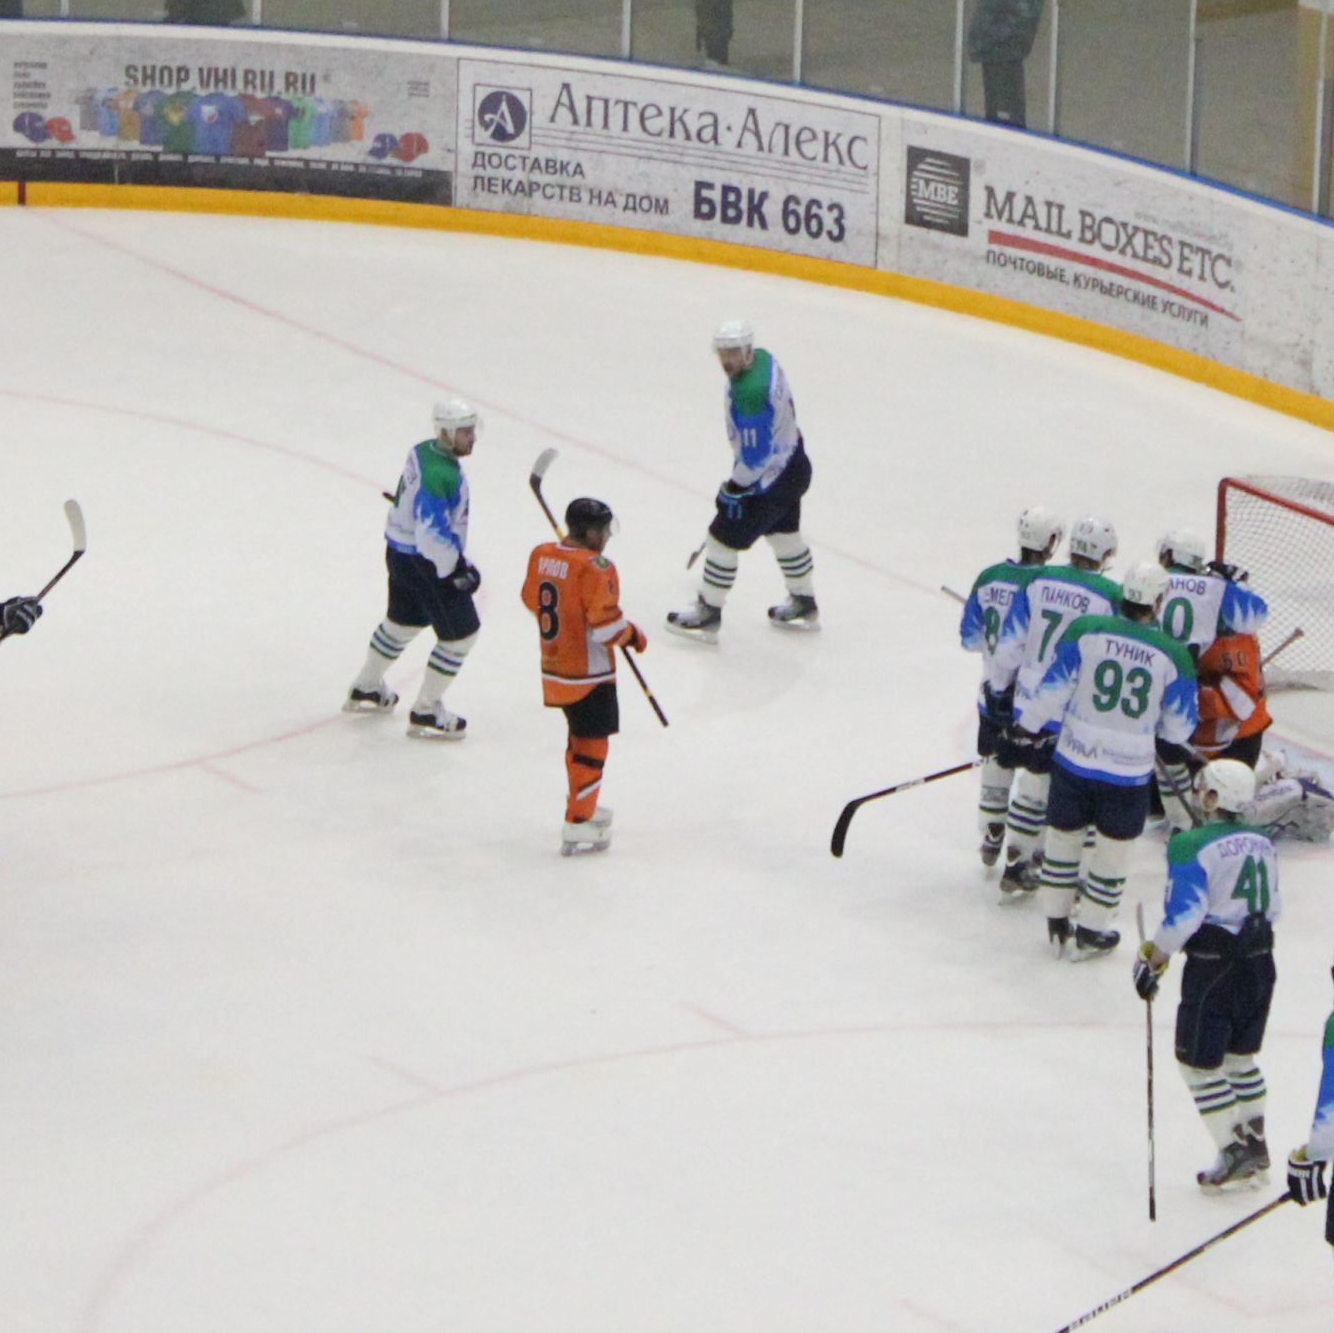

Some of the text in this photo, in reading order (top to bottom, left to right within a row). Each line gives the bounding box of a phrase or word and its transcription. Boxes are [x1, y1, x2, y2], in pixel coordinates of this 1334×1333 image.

[471, 150, 586, 180] ДОСТАВКА
[471, 174, 670, 217] ЛЕКАРСТВ НА ДОМ
[693, 179, 847, 244] БВК 663
[917, 178, 960, 206] MBE
[983, 184, 1072, 239] MAIL
[1078, 208, 1174, 269] BOXES
[1177, 239, 1237, 293] ETC.
[985, 248, 1211, 329] ПОЧТОВЫЕ, КУРЬЕРСКИЕ УСЛУГИ
[538, 581, 560, 641] 8
[1042, 585, 1091, 614] ПАНКОВ
[1169, 577, 1207, 596] АНОВ
[1105, 638, 1156, 669] ТУНИК
[1092, 659, 1153, 720] 93
[1230, 854, 1271, 915] 41
